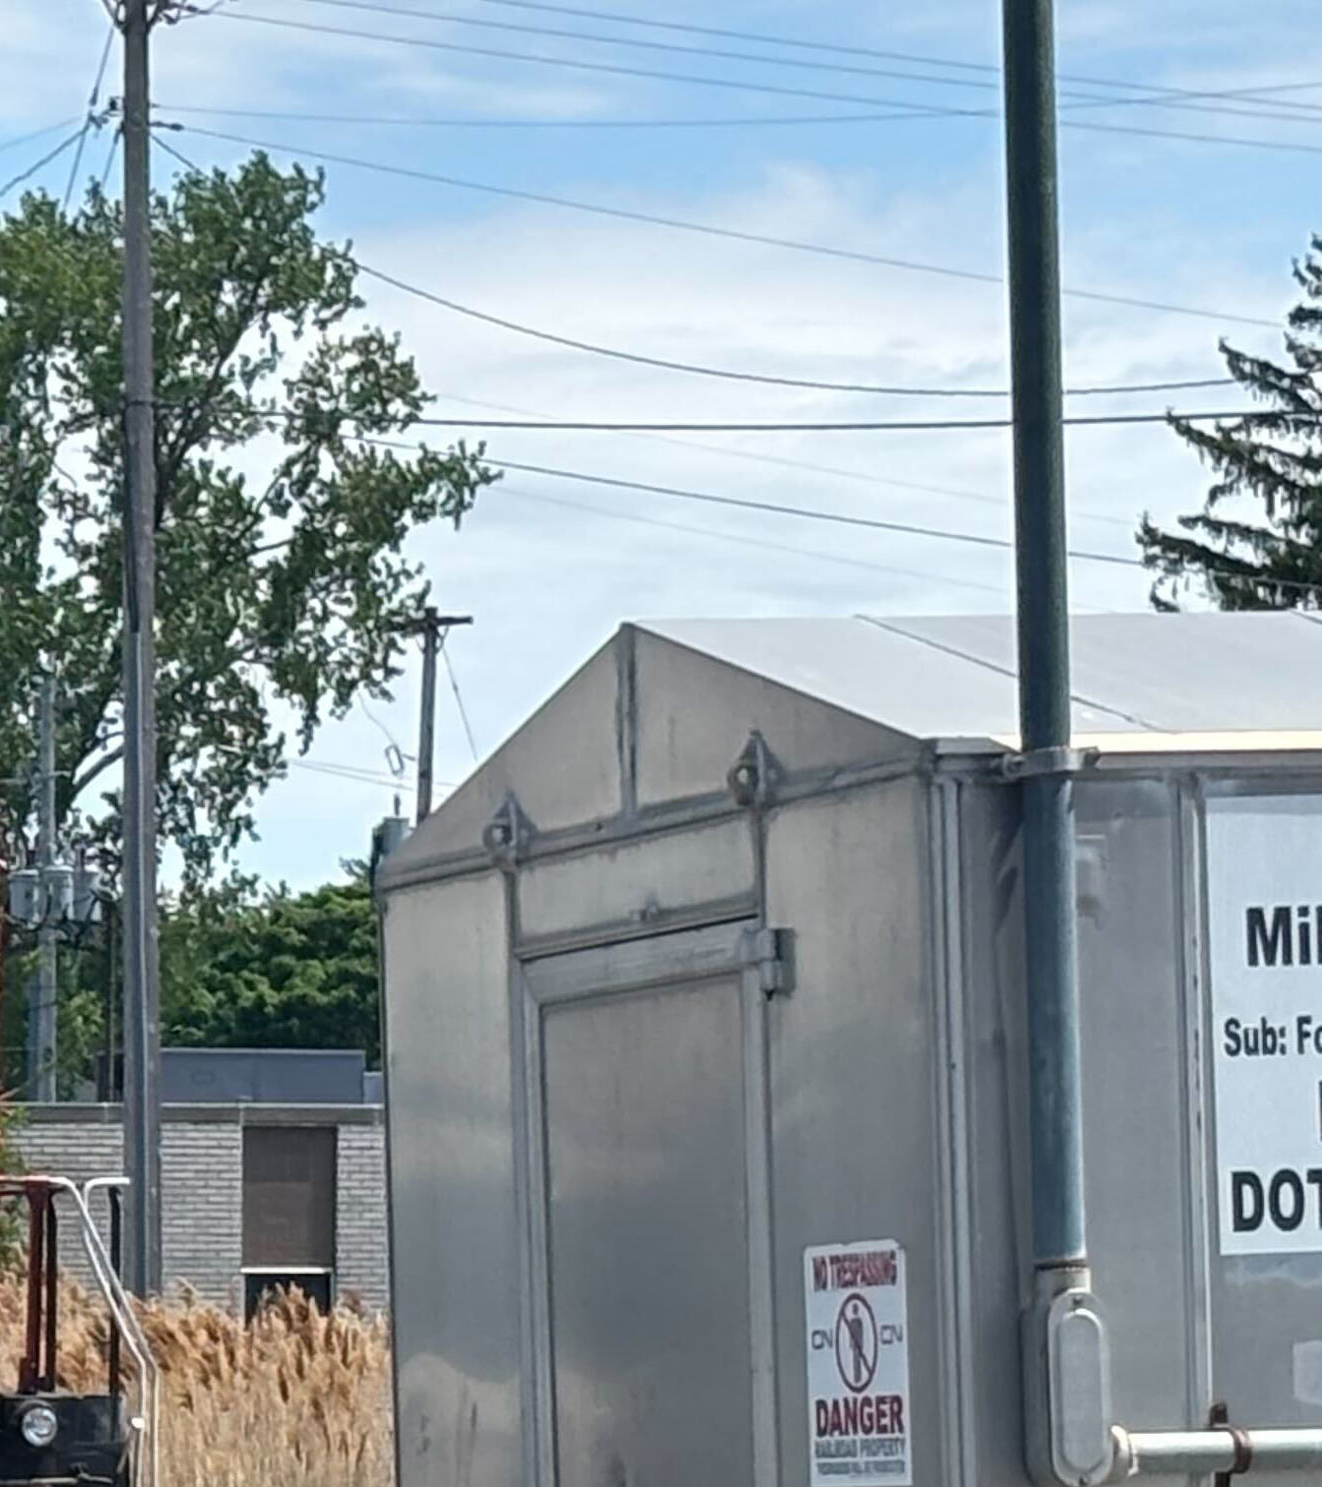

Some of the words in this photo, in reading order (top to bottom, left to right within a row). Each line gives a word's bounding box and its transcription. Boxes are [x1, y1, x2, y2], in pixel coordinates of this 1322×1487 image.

[1224, 1017, 1287, 1057] Sub:
[813, 1255, 828, 1292] NO
[812, 1328, 833, 1351] CN
[880, 1323, 903, 1346] CN
[815, 1394, 904, 1438] DANGER
